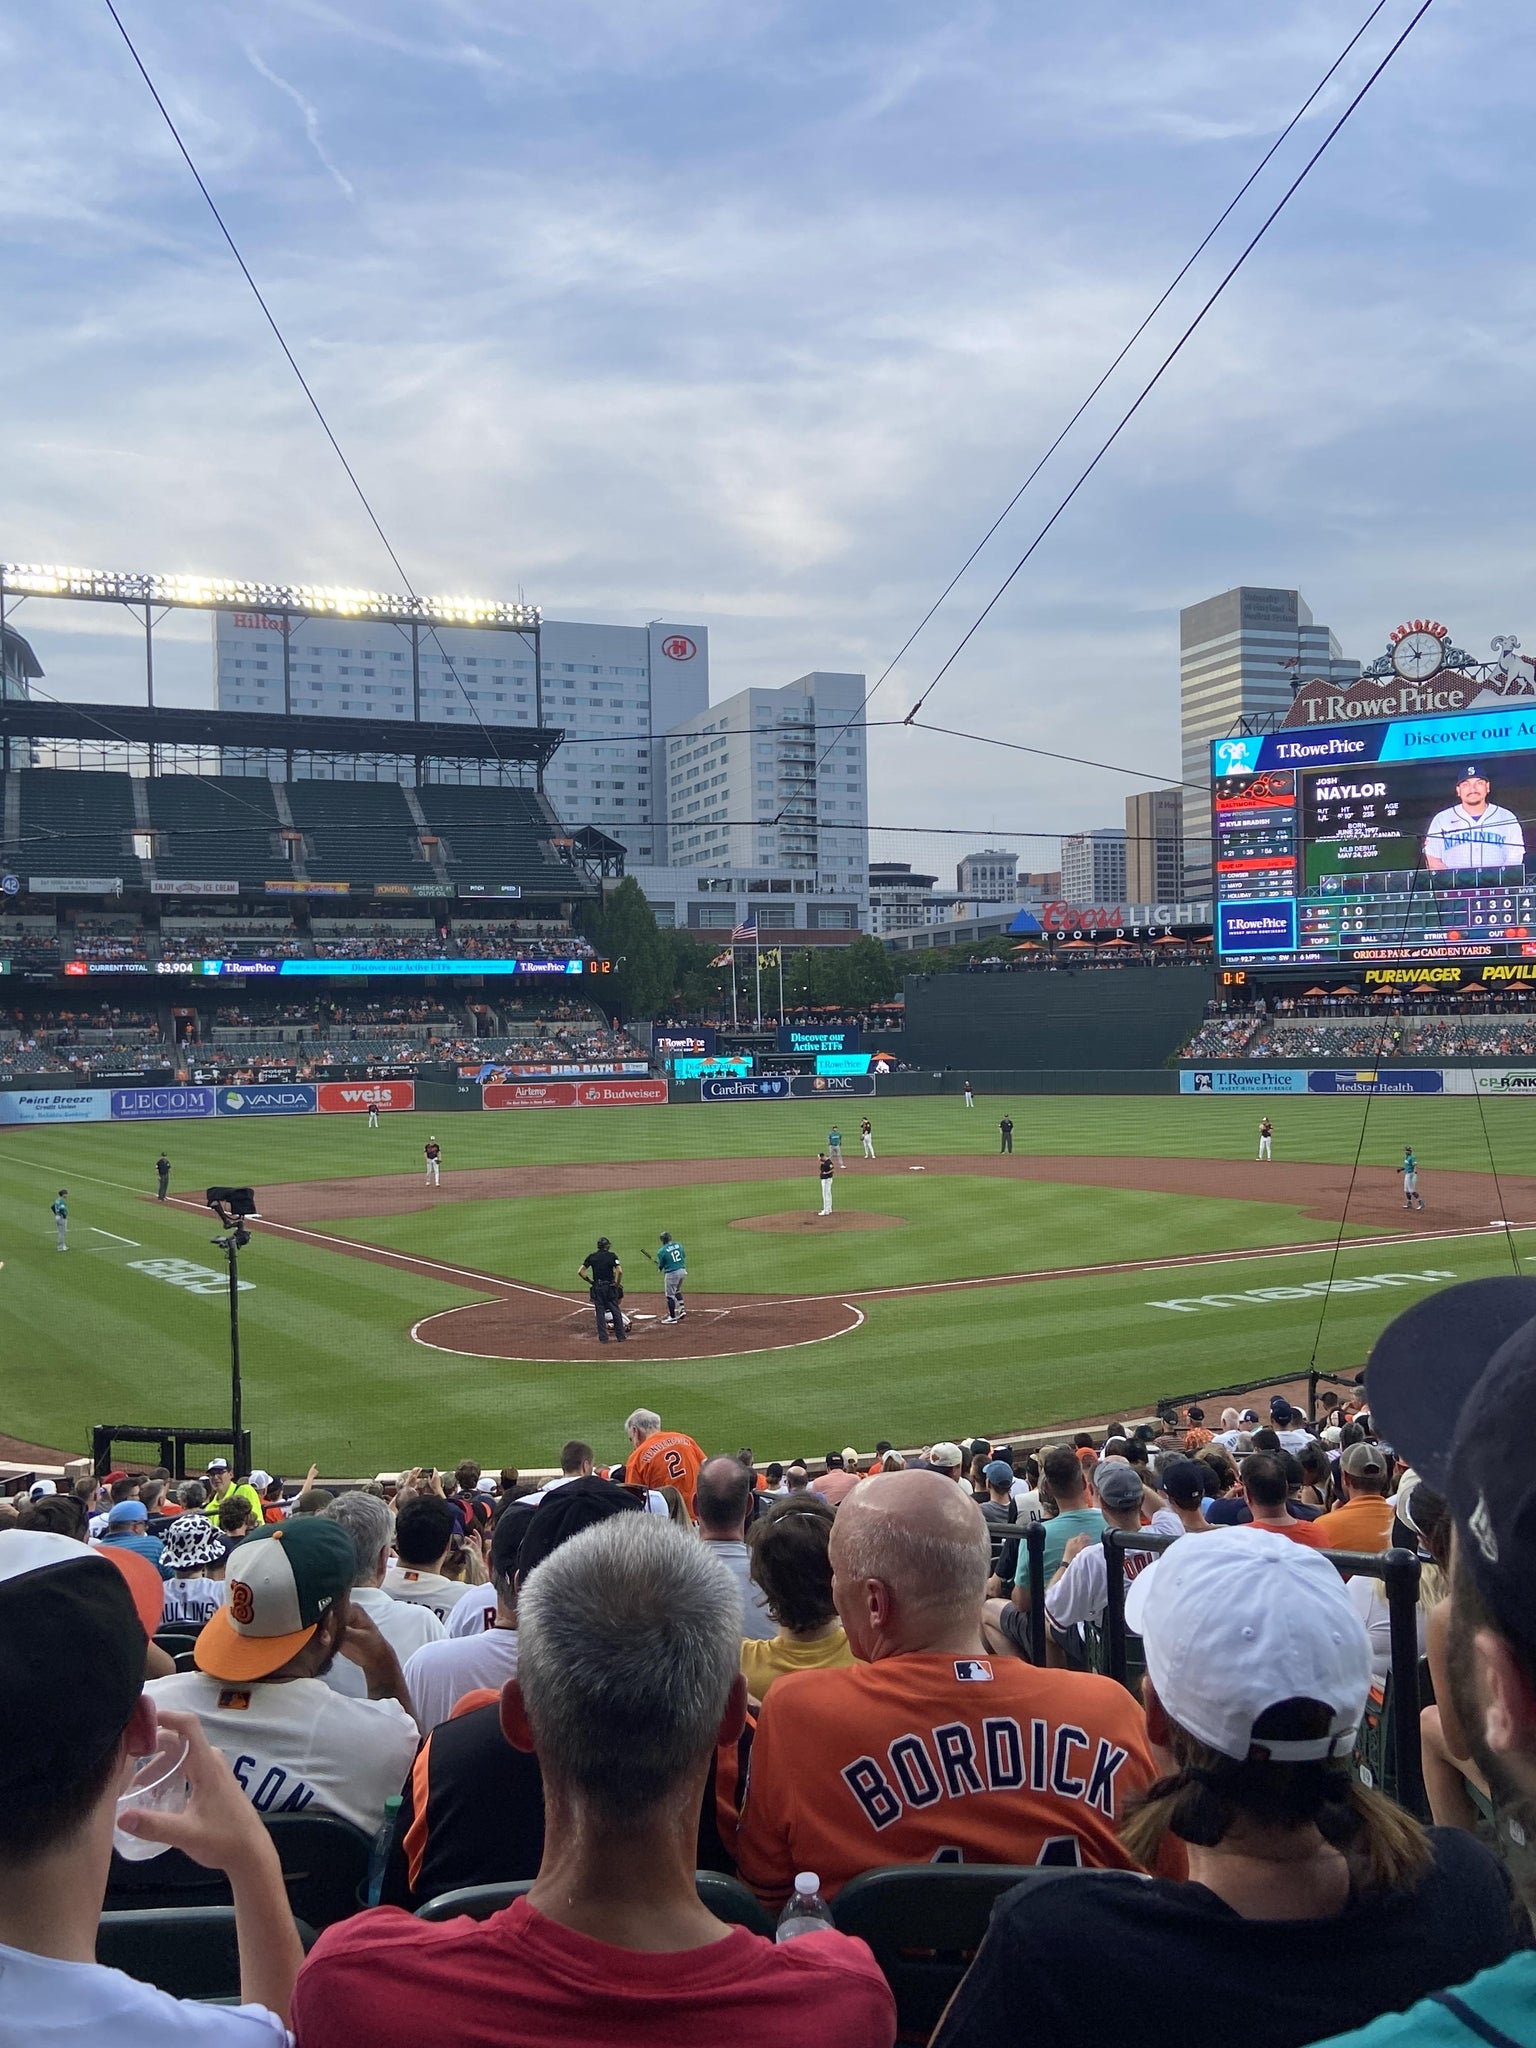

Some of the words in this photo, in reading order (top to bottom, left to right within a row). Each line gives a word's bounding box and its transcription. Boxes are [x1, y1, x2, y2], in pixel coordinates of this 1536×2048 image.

[1404, 731, 1478, 746] Discover
[1482, 727, 1512, 740] our
[1315, 776, 1338, 786] JOSH
[1316, 783, 1386, 800] NAYLOR
[1387, 809, 1396, 817] 28
[1444, 831, 1507, 851] MARINERS
[1339, 845, 1354, 853] MLB
[1354, 844, 1377, 852] DEBUT
[4, 880, 17, 889] 42
[155, 883, 174, 891] ENJOY
[215, 884, 235, 892] CREAM
[1342, 907, 1348, 915] 1
[1355, 907, 1363, 915] 0
[1475, 901, 1481, 909] 1
[1489, 900, 1497, 909] 3
[1503, 899, 1511, 908] 0
[1522, 898, 1530, 907] 4
[1042, 900, 1125, 931] Coors
[1129, 902, 1209, 927] LIGHT
[1341, 921, 1349, 930] 0
[1355, 921, 1363, 929] 0
[1475, 915, 1483, 924] 0
[1489, 914, 1497, 923] 0
[1503, 914, 1512, 923] 0
[1522, 913, 1531, 922] 4
[1041, 930, 1097, 942] ROOF
[1116, 926, 1173, 938] DECK
[1361, 935, 1378, 943] BALL
[1353, 950, 1387, 959] ORIOLE
[1387, 949, 1410, 958] PARK
[1421, 947, 1460, 957] CAMDEN
[1461, 946, 1492, 955] YARDS
[157, 962, 194, 973] $3,904
[351, 963, 386, 972] Discover
[405, 963, 428, 971] Active
[430, 963, 451, 971] ETFs
[1365, 967, 1461, 984] PUREWAGER
[791, 1033, 828, 1042] Discover
[829, 1033, 845, 1041] our
[793, 1042, 820, 1051] Active
[821, 1041, 843, 1051] ETFs
[550, 1064, 580, 1074] BIRD
[583, 1063, 614, 1073] BATH
[711, 1082, 759, 1096] CareFirst
[827, 1078, 852, 1088] PNC
[1336, 1083, 1378, 1092] MedStar
[1380, 1083, 1414, 1092] Health
[340, 1085, 392, 1103] weis
[515, 1087, 546, 1098] Airtemp
[604, 1088, 661, 1100] Budweiser
[53, 1095, 93, 1104] Breeze
[245, 1093, 308, 1105] VANDA
[670, 1250, 682, 1262] 12
[664, 1449, 687, 1480] 2
[840, 1716, 1128, 1832] BORDICK
